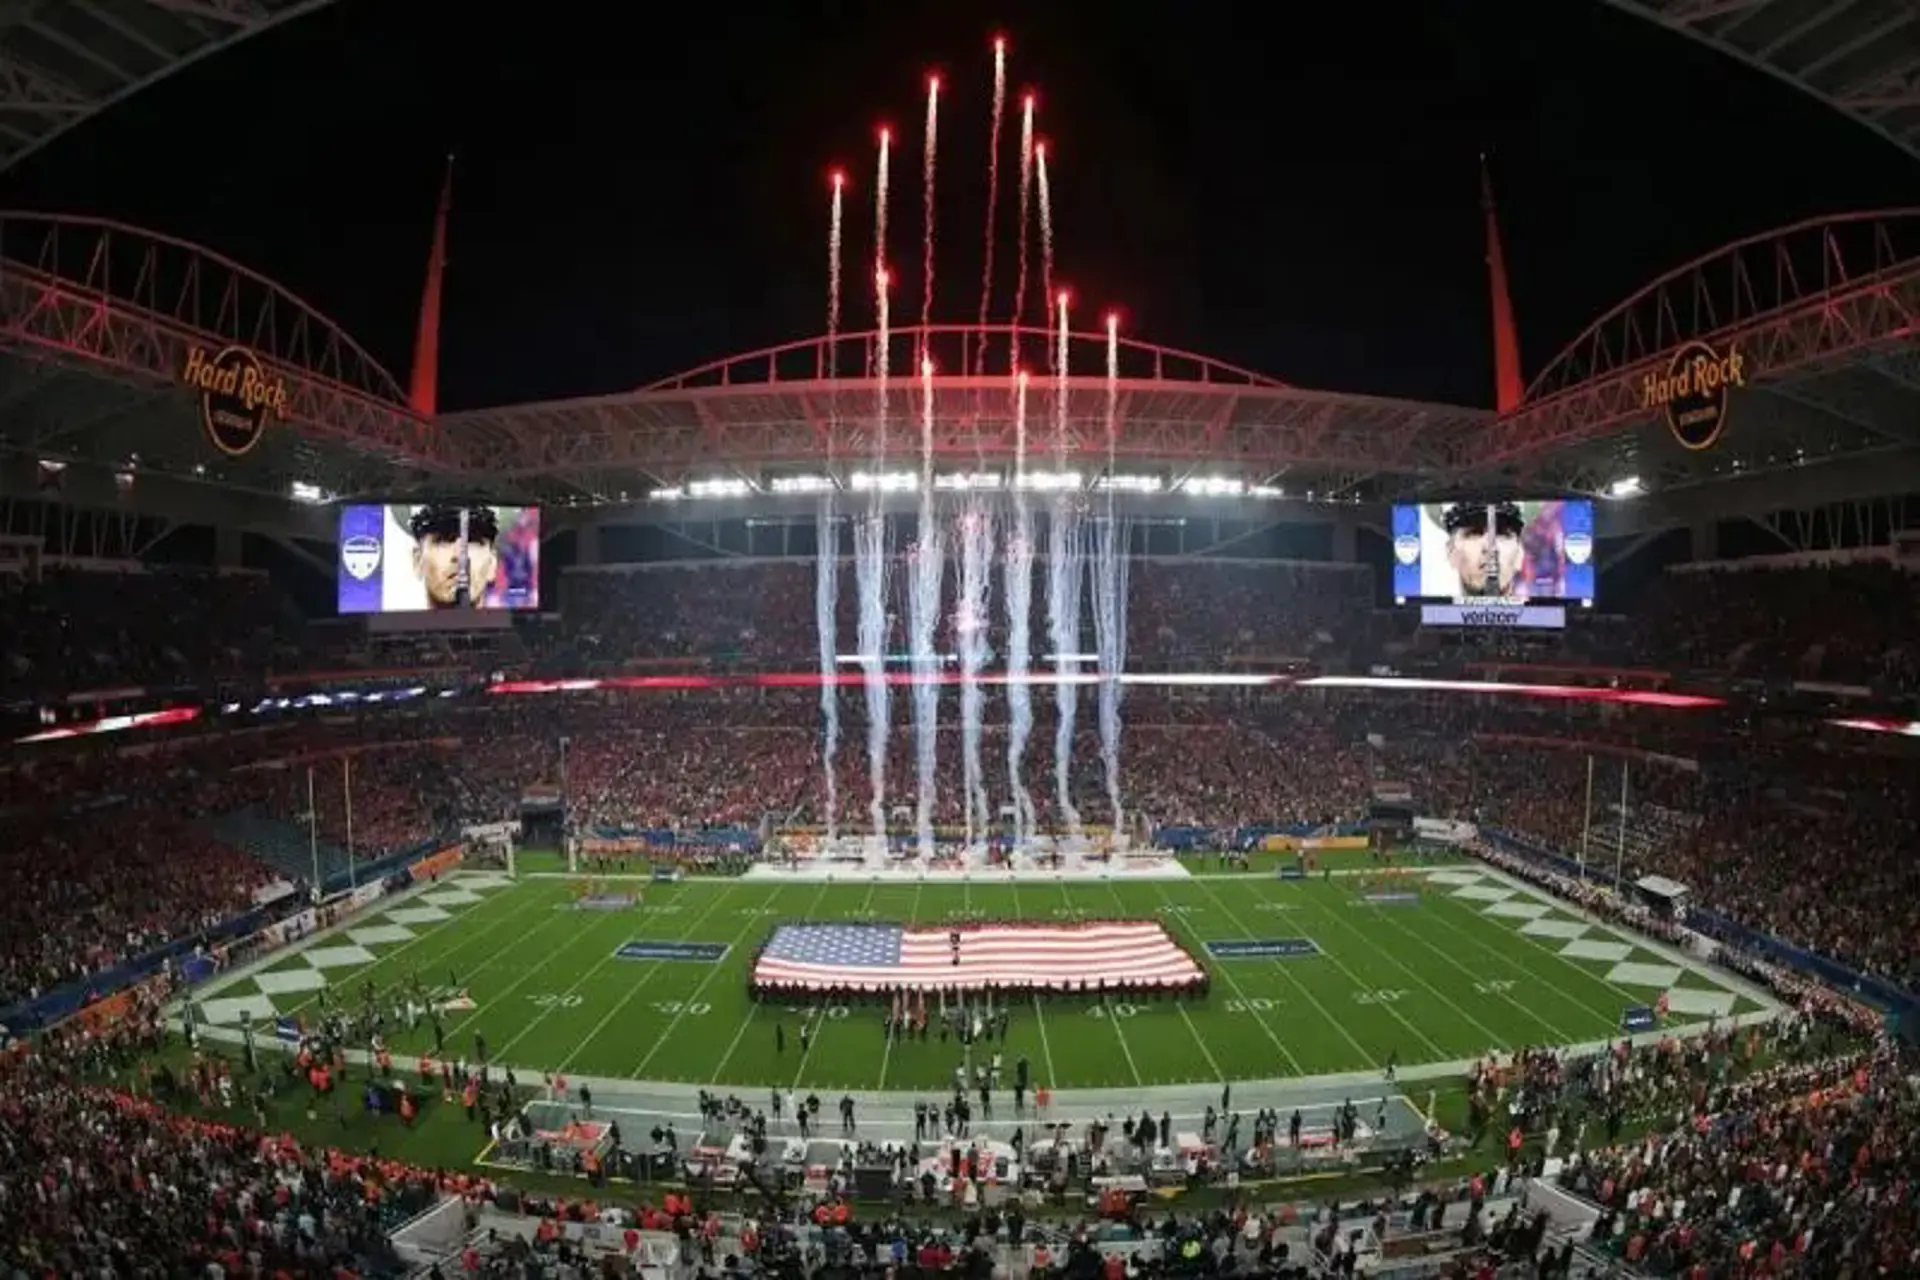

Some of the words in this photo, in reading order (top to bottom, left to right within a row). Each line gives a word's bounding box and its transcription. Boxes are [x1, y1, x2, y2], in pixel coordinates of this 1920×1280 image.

[184, 347, 241, 395] Hard
[239, 366, 290, 419] Rock
[1643, 359, 1691, 411] Hard
[1692, 342, 1745, 398] Rock
[1460, 606, 1520, 624] verizon
